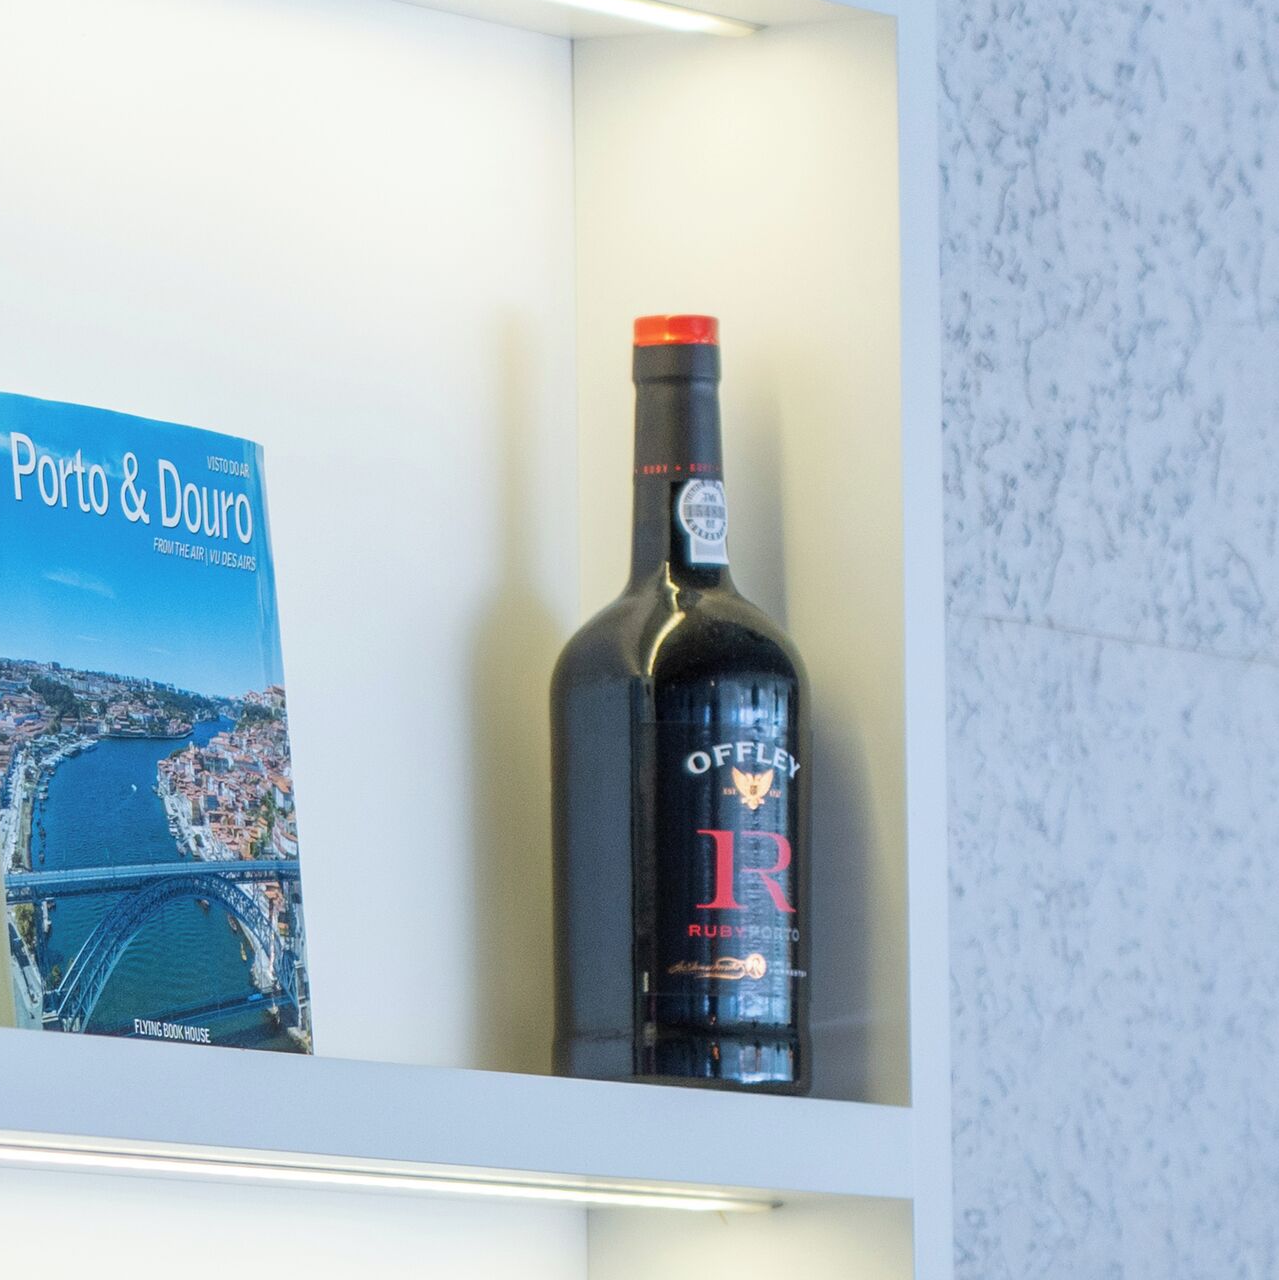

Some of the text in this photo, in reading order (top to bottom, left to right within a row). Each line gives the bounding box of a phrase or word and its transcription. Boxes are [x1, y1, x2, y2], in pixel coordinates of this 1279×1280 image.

[206, 455, 250, 479] VISTO DO AR
[10, 431, 253, 544] Porto & Douro
[154, 537, 174, 555] FROM
[175, 541, 190, 559] THE
[191, 545, 204, 561] AIR
[210, 549, 221, 565] VU
[222, 551, 238, 568] DES
[238, 554, 257, 572] AIRS
[687, 741, 801, 779] OFFLEY
[696, 829, 797, 913] R
[688, 924, 747, 939] RUBY
[134, 1018, 212, 1043] FLYING BOOK HOUSE
